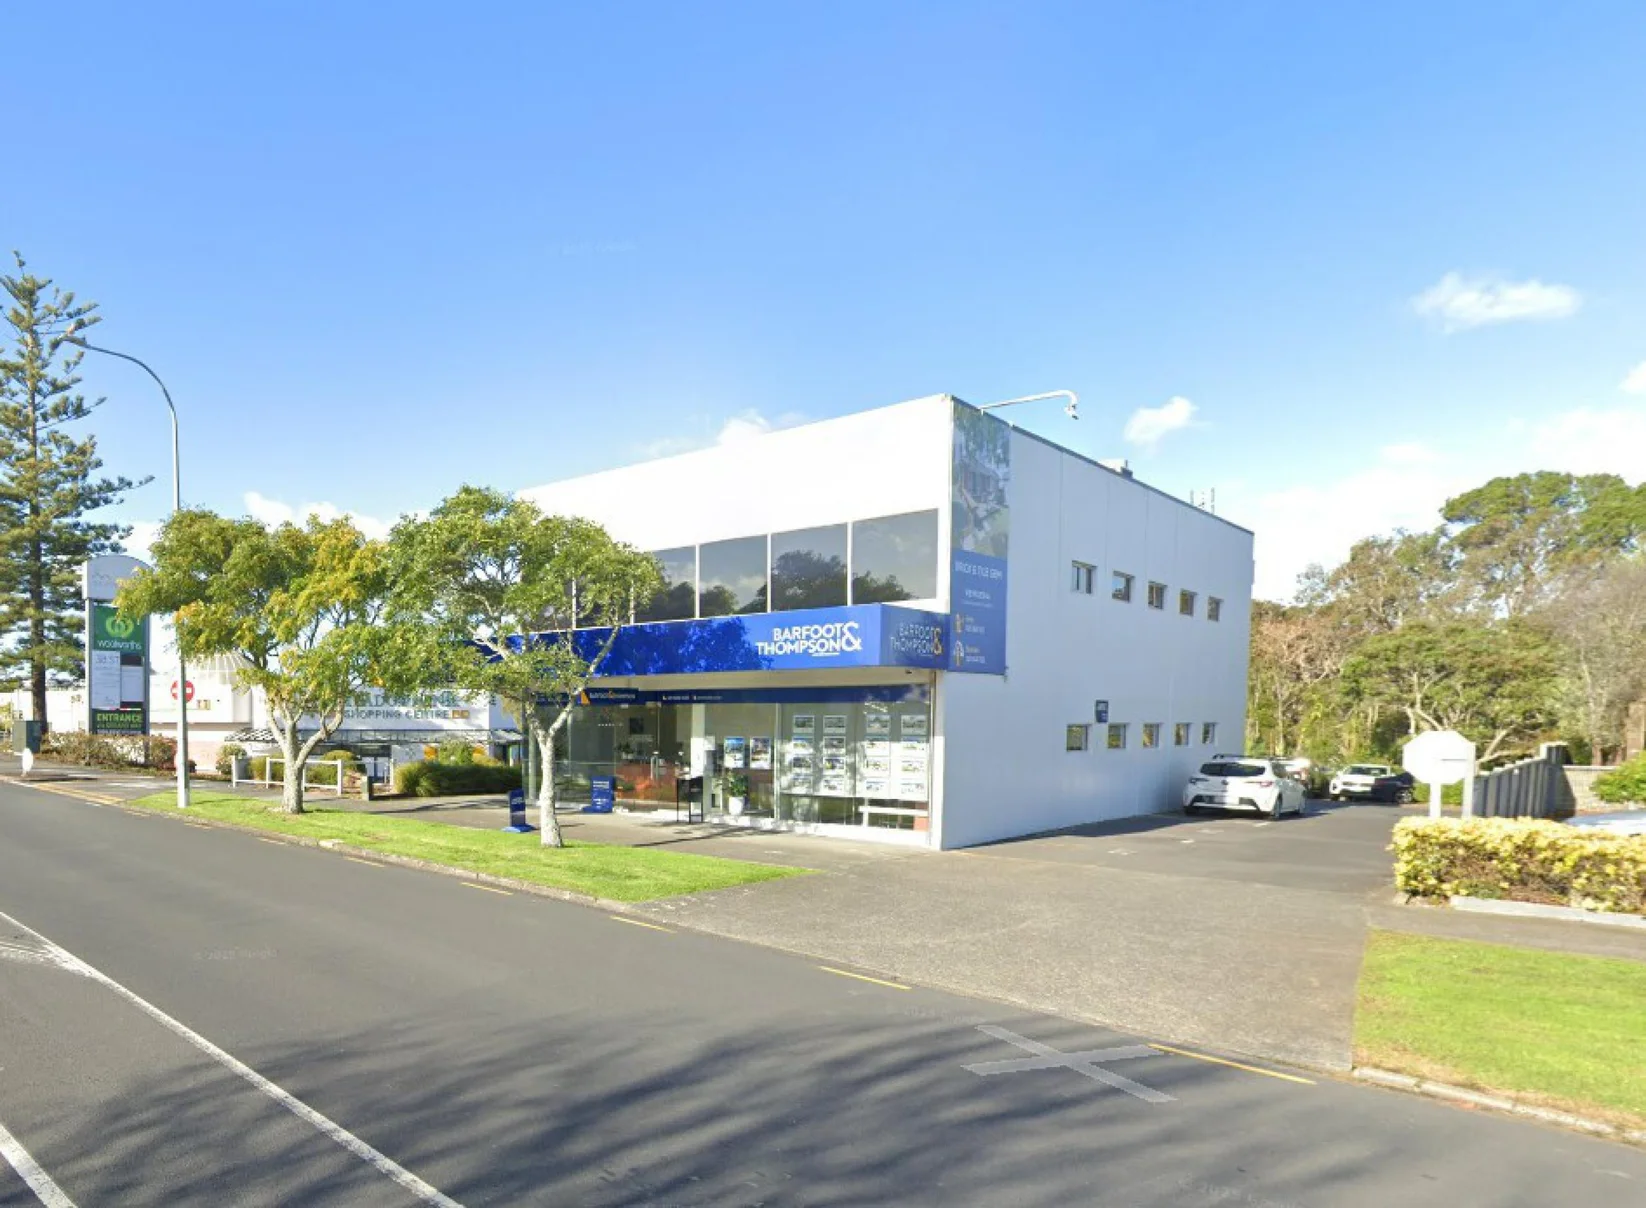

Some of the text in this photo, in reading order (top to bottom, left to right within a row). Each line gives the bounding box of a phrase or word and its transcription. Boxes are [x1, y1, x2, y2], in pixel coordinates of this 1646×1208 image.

[773, 620, 863, 652] BARFOOT &
[755, 638, 841, 655] THOMPSON
[96, 713, 143, 723] ENTRANCE
[343, 709, 400, 720] SHOPPING
